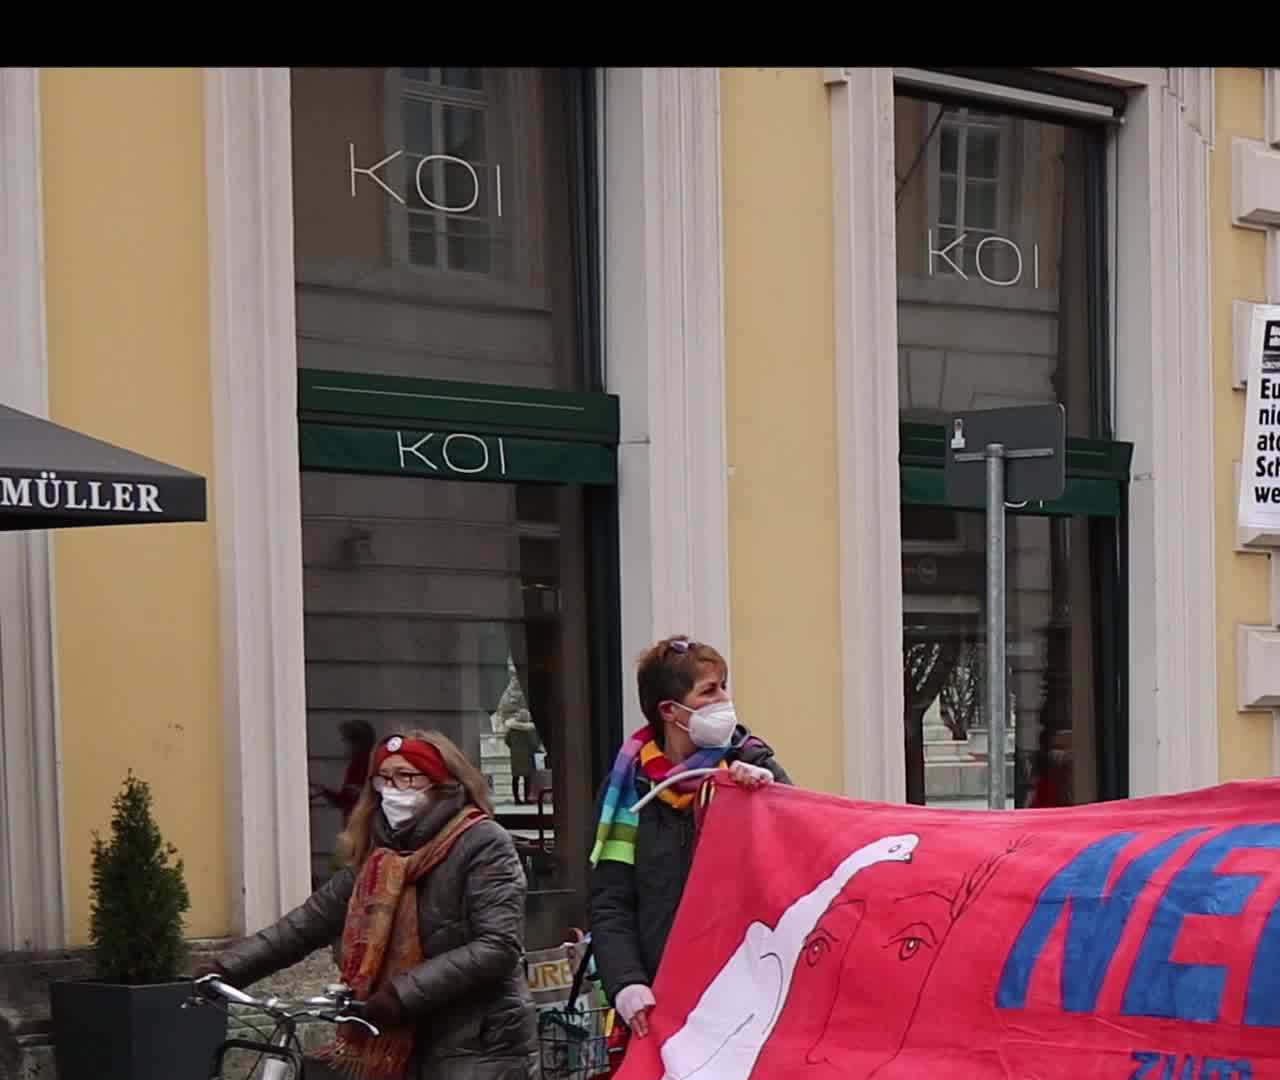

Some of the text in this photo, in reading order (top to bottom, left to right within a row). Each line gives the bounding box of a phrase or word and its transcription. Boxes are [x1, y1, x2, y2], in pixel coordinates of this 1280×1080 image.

[350, 143, 502, 217] KOI
[928, 229, 1038, 288] KOI
[397, 431, 505, 474] KOI
[0, 471, 164, 513] MÜLLER
